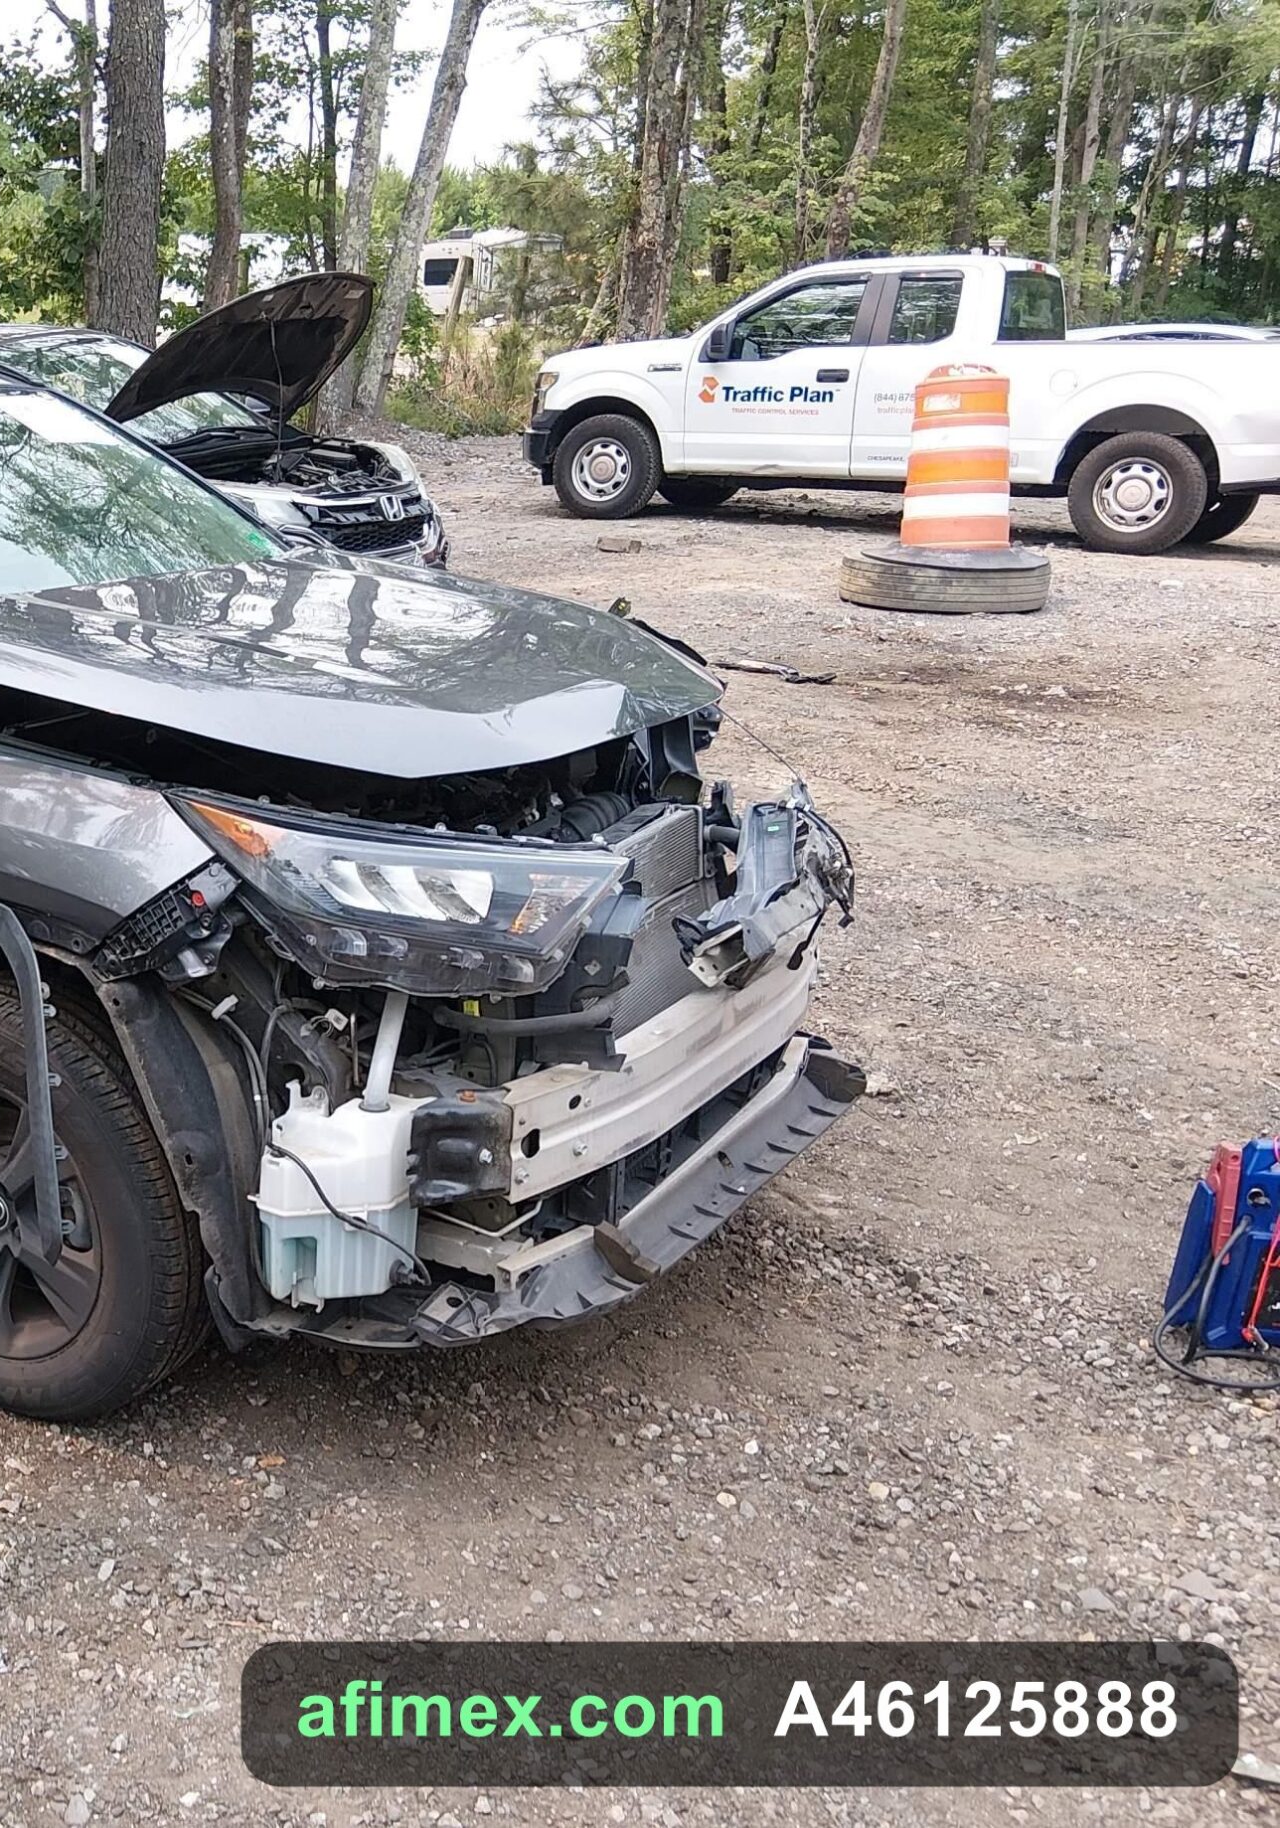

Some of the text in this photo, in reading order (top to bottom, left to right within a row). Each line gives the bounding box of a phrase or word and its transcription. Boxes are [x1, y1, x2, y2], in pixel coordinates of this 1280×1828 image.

[722, 386, 834, 403] Traffic Plan
[874, 393, 897, 404] (844)
